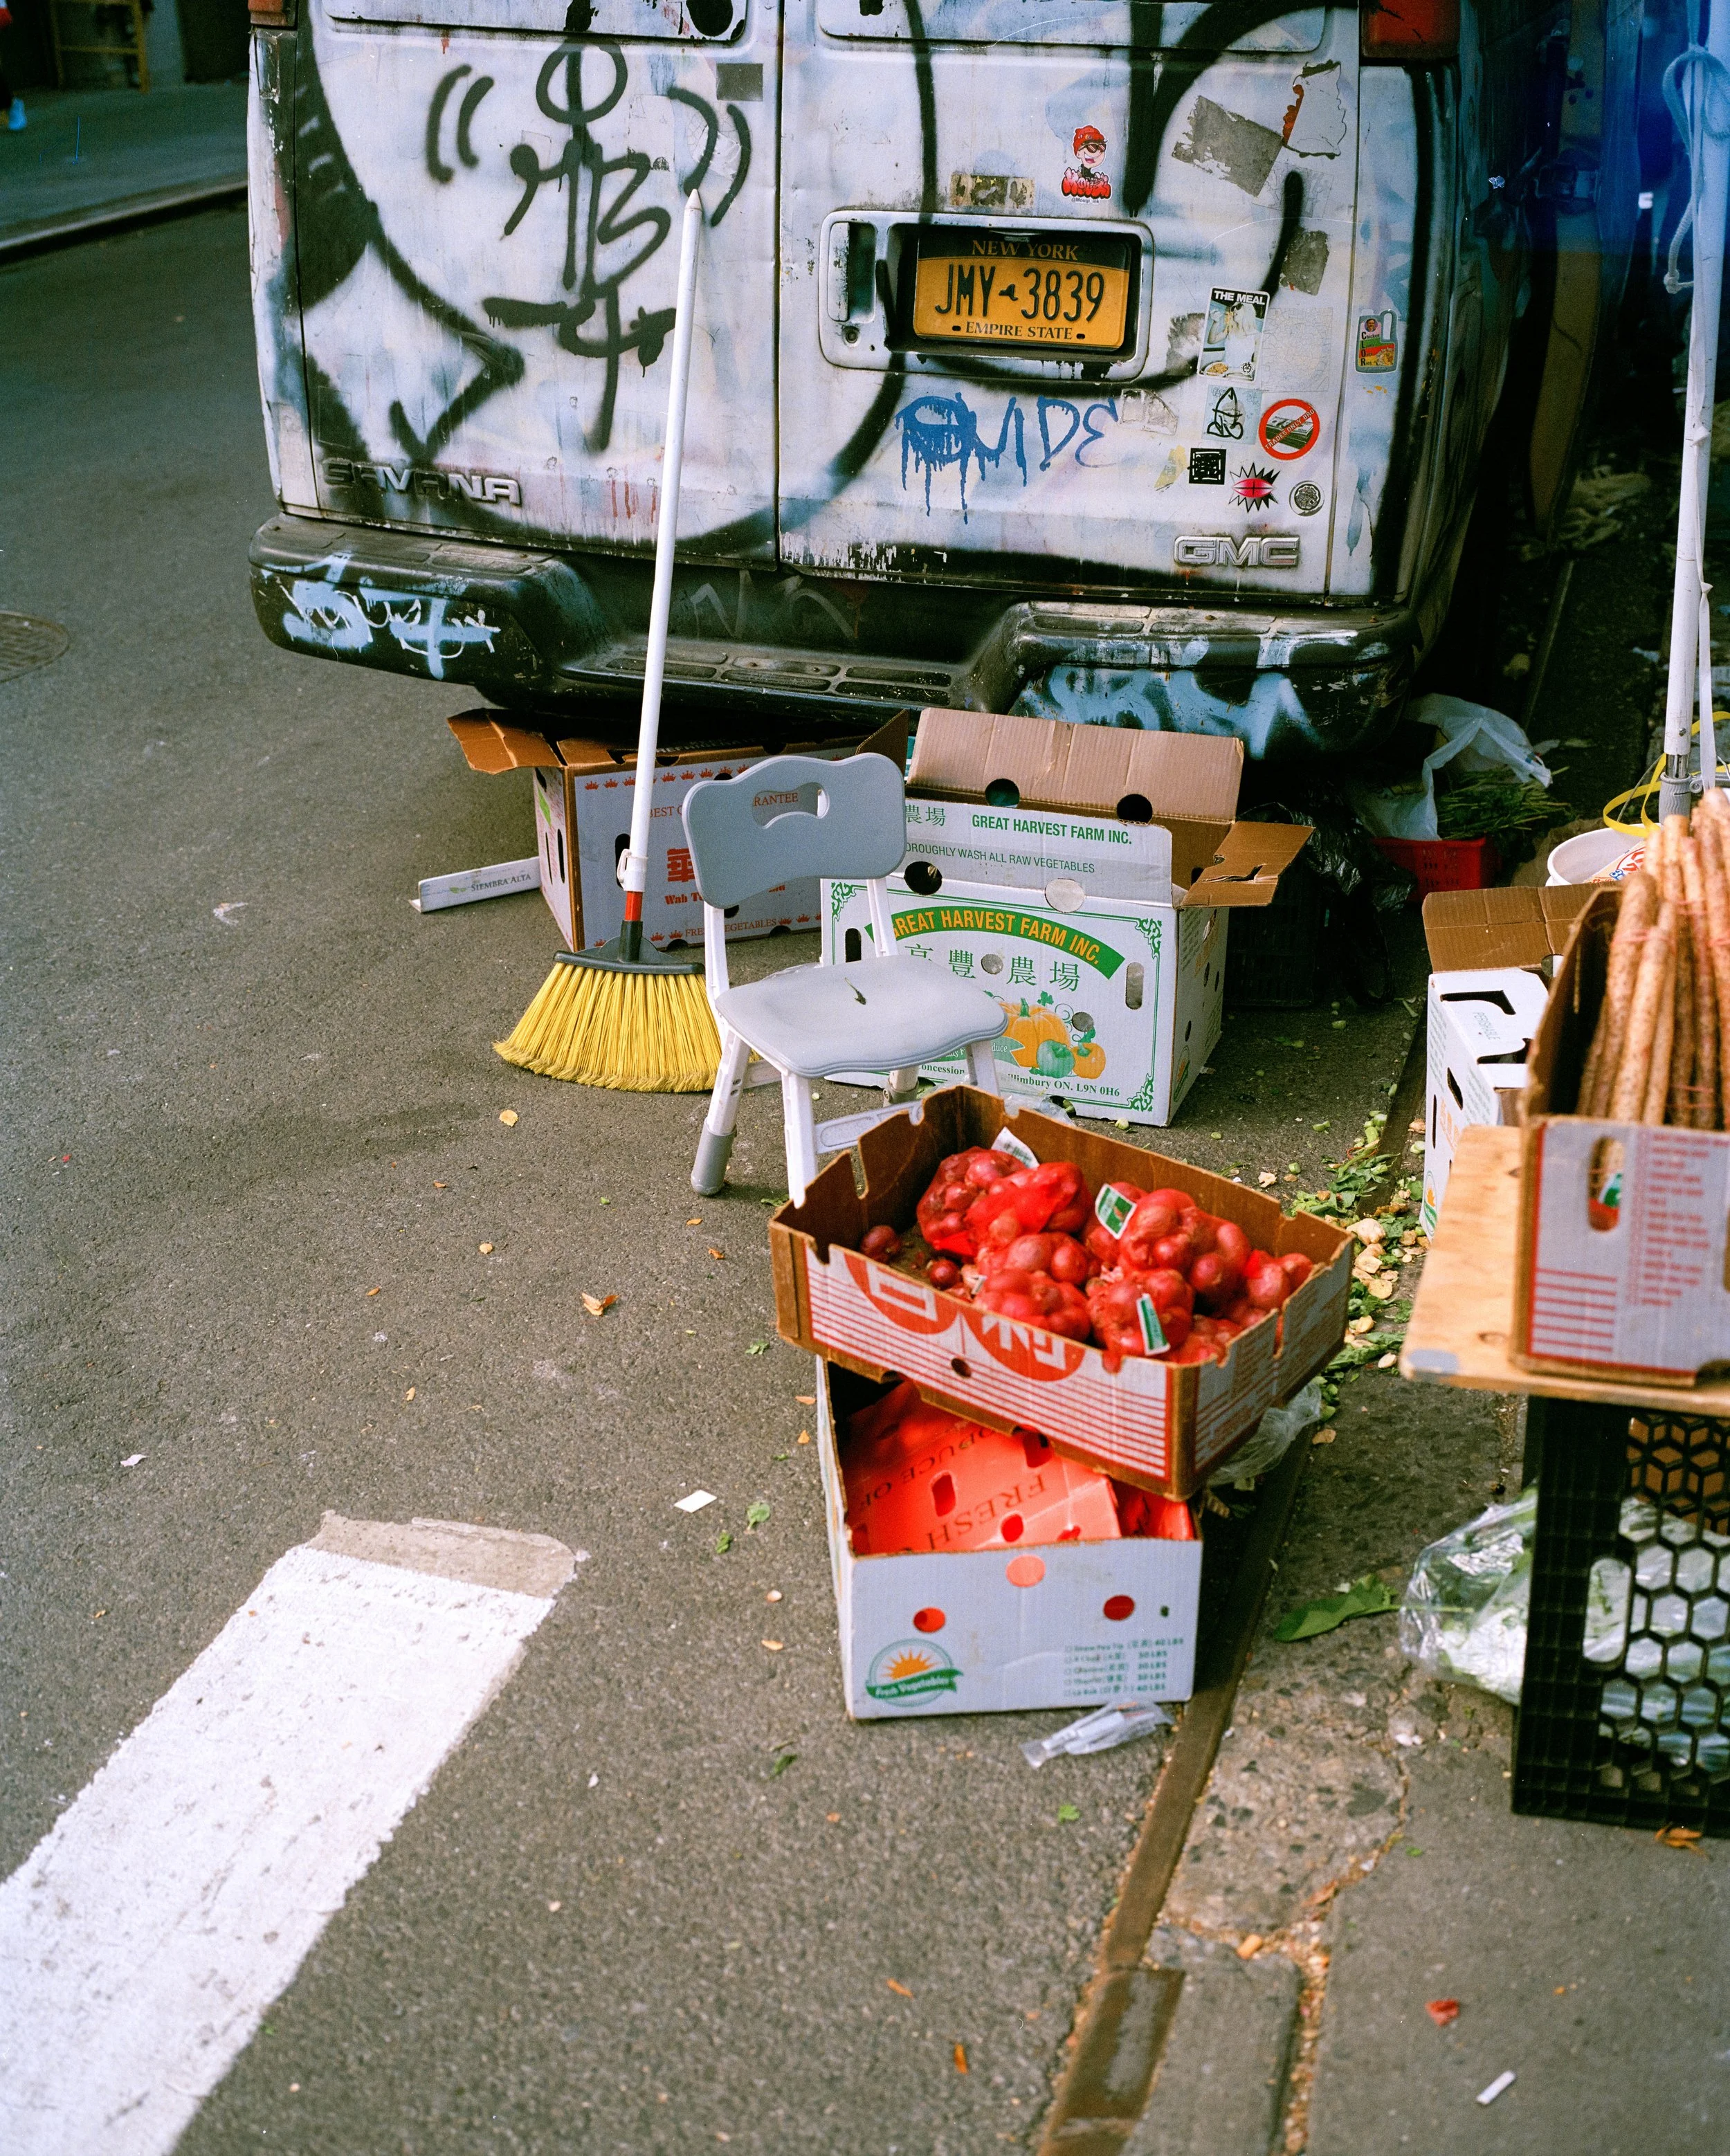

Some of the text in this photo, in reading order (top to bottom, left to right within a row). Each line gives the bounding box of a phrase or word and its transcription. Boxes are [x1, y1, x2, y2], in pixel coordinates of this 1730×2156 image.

[972, 240, 1078, 260] NEW YORK
[935, 264, 1104, 322] JMY 3839
[1214, 291, 1265, 305] THE MEAL
[966, 322, 1073, 340] EMPIRE STATE
[1265, 409, 1315, 450] TRADES ONLY BRO
[323, 458, 522, 506] SAVANA
[1174, 536, 1300, 566] GMC
[754, 793, 799, 807] RANTEE
[905, 805, 947, 827] 農場
[972, 814, 1132, 845] GREAT HARVEST FARM INC.
[906, 843, 1095, 873] OROUGHLY WASH ALL RAW VEGETABLES
[686, 918, 776, 937] FRE EGETABLES
[940, 910, 1017, 932] HARVEST
[1020, 917, 1067, 947] FARM
[1069, 935, 1100, 965] INC.
[992, 1043, 1008, 1052] duce
[920, 1063, 965, 1075] oncession
[1054, 1081, 1073, 1090] ON.
[1076, 1084, 1097, 1094] L9N
[927, 1474, 1046, 1550] FRESH
